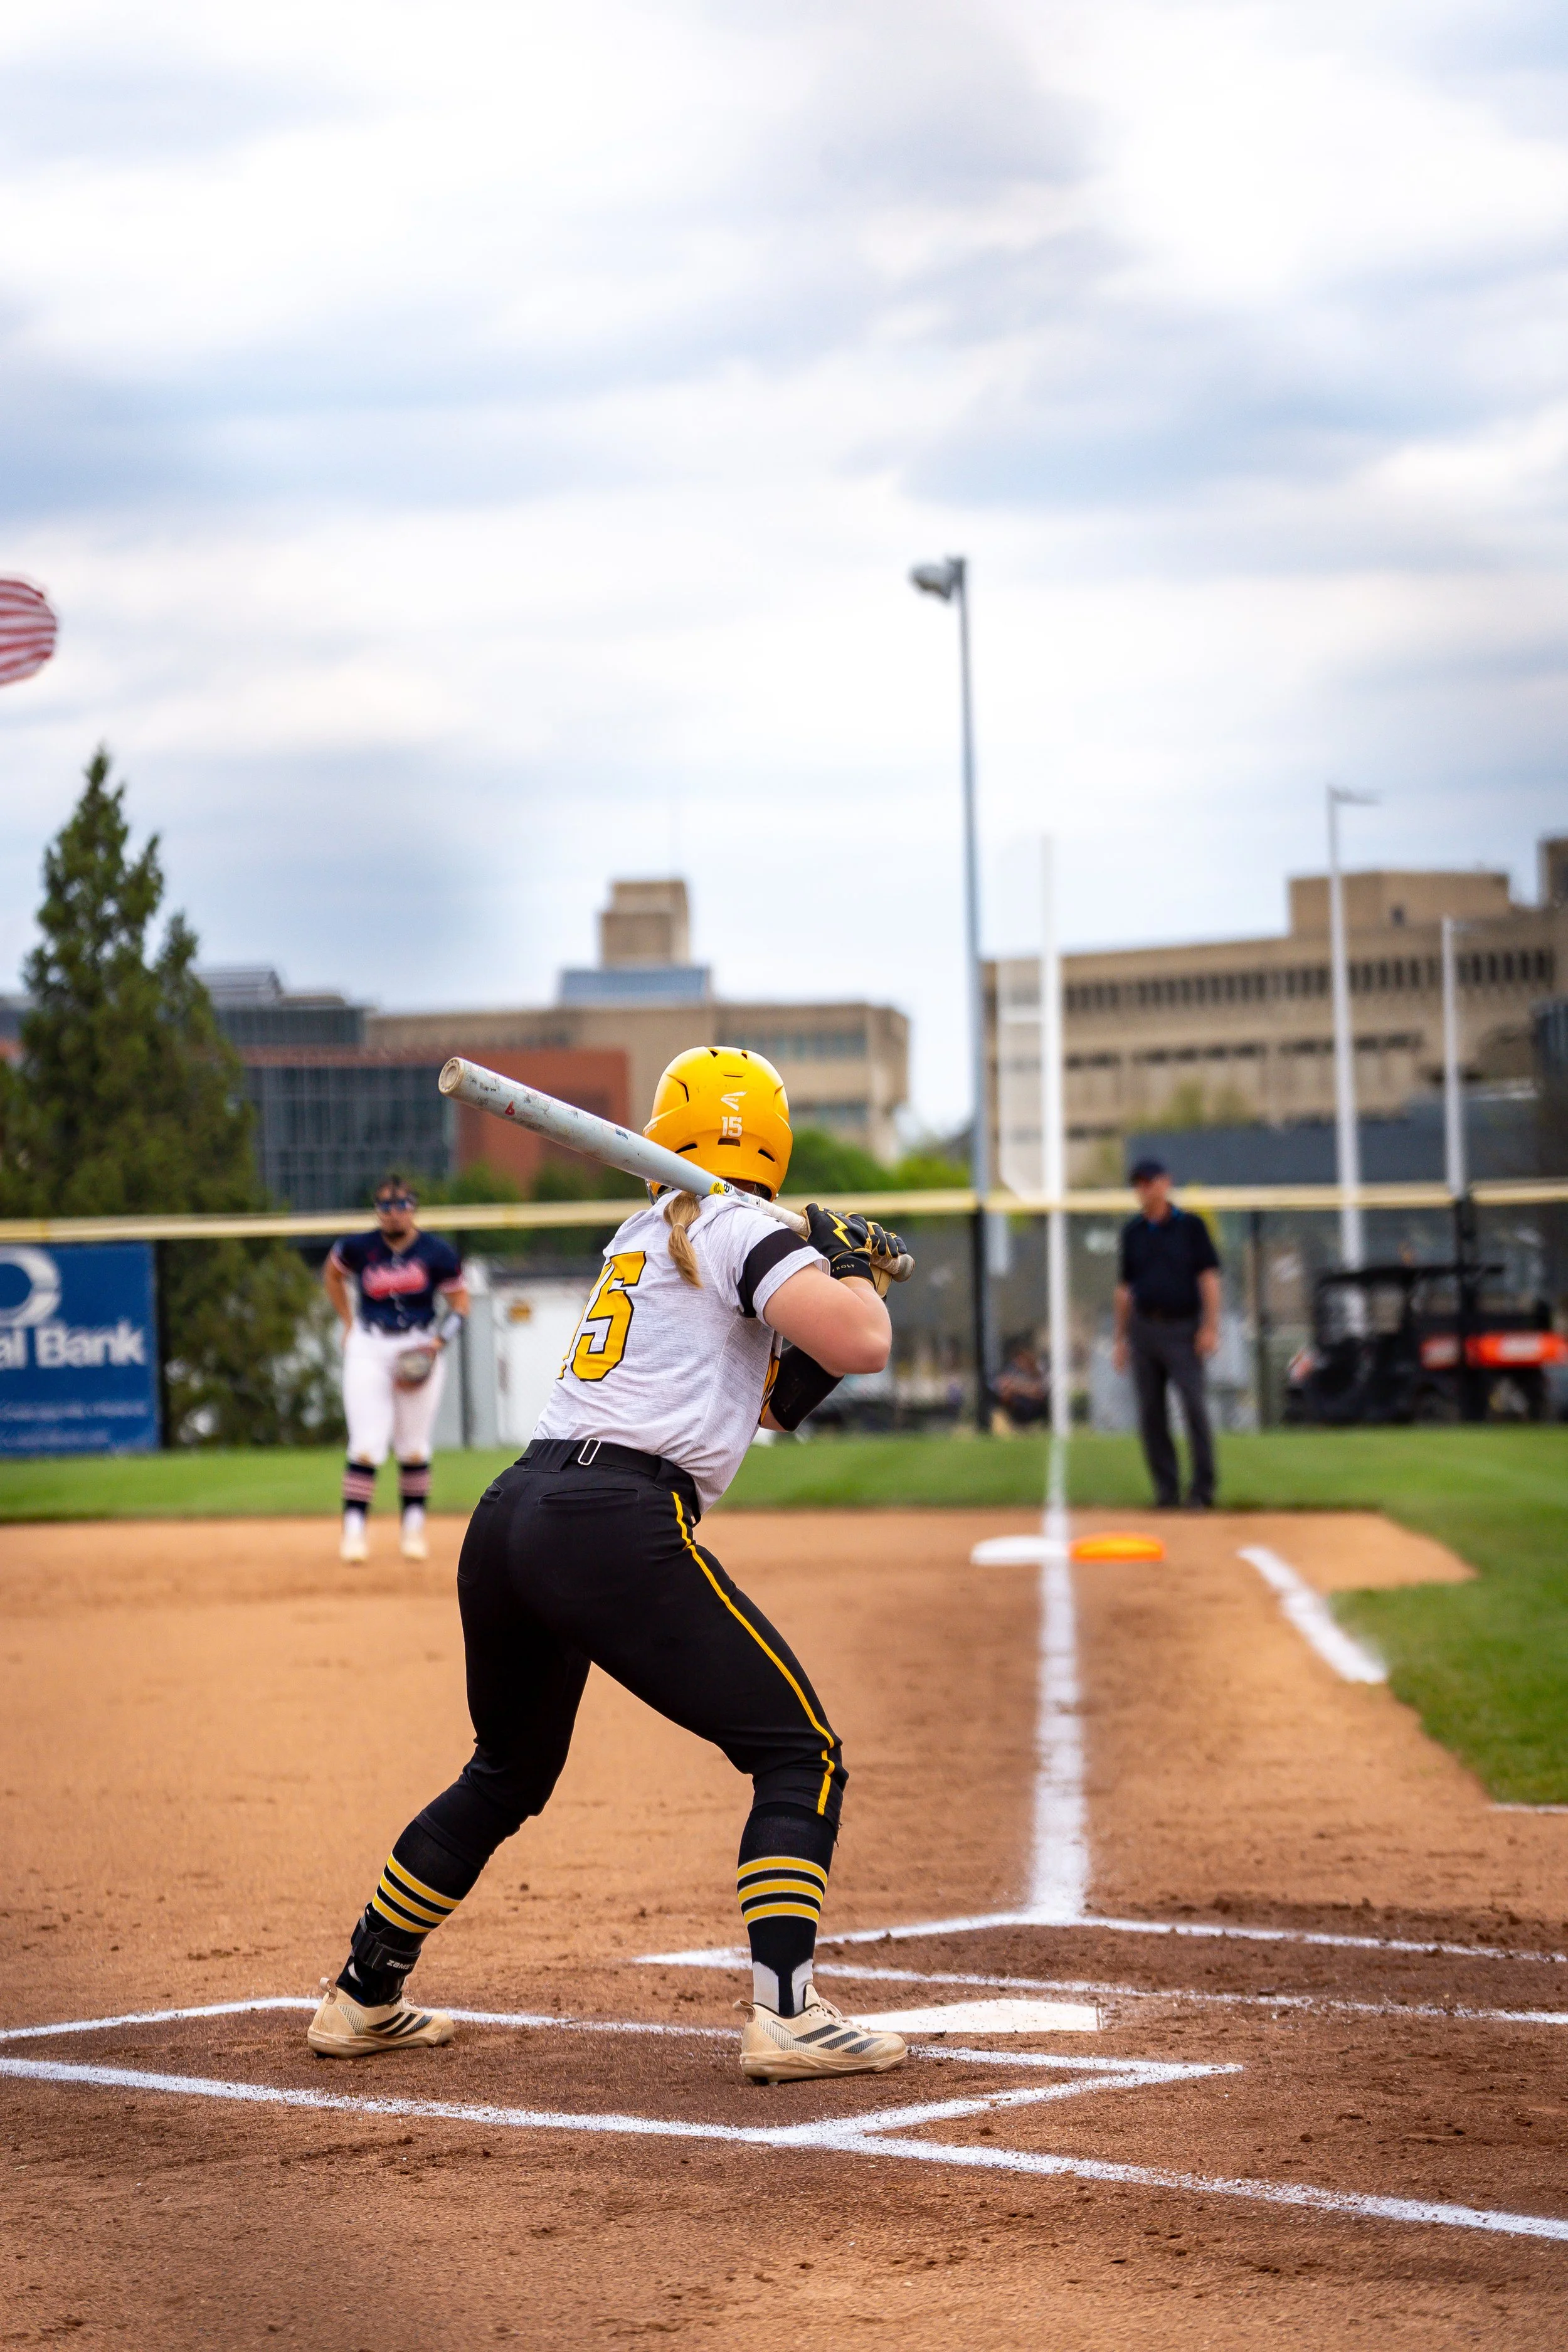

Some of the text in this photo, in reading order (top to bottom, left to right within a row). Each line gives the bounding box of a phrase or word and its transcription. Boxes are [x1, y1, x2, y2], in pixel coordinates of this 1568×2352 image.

[721, 1116, 743, 1137] 15
[556, 1251, 647, 1382] 5
[35, 1318, 146, 1369] Bank
